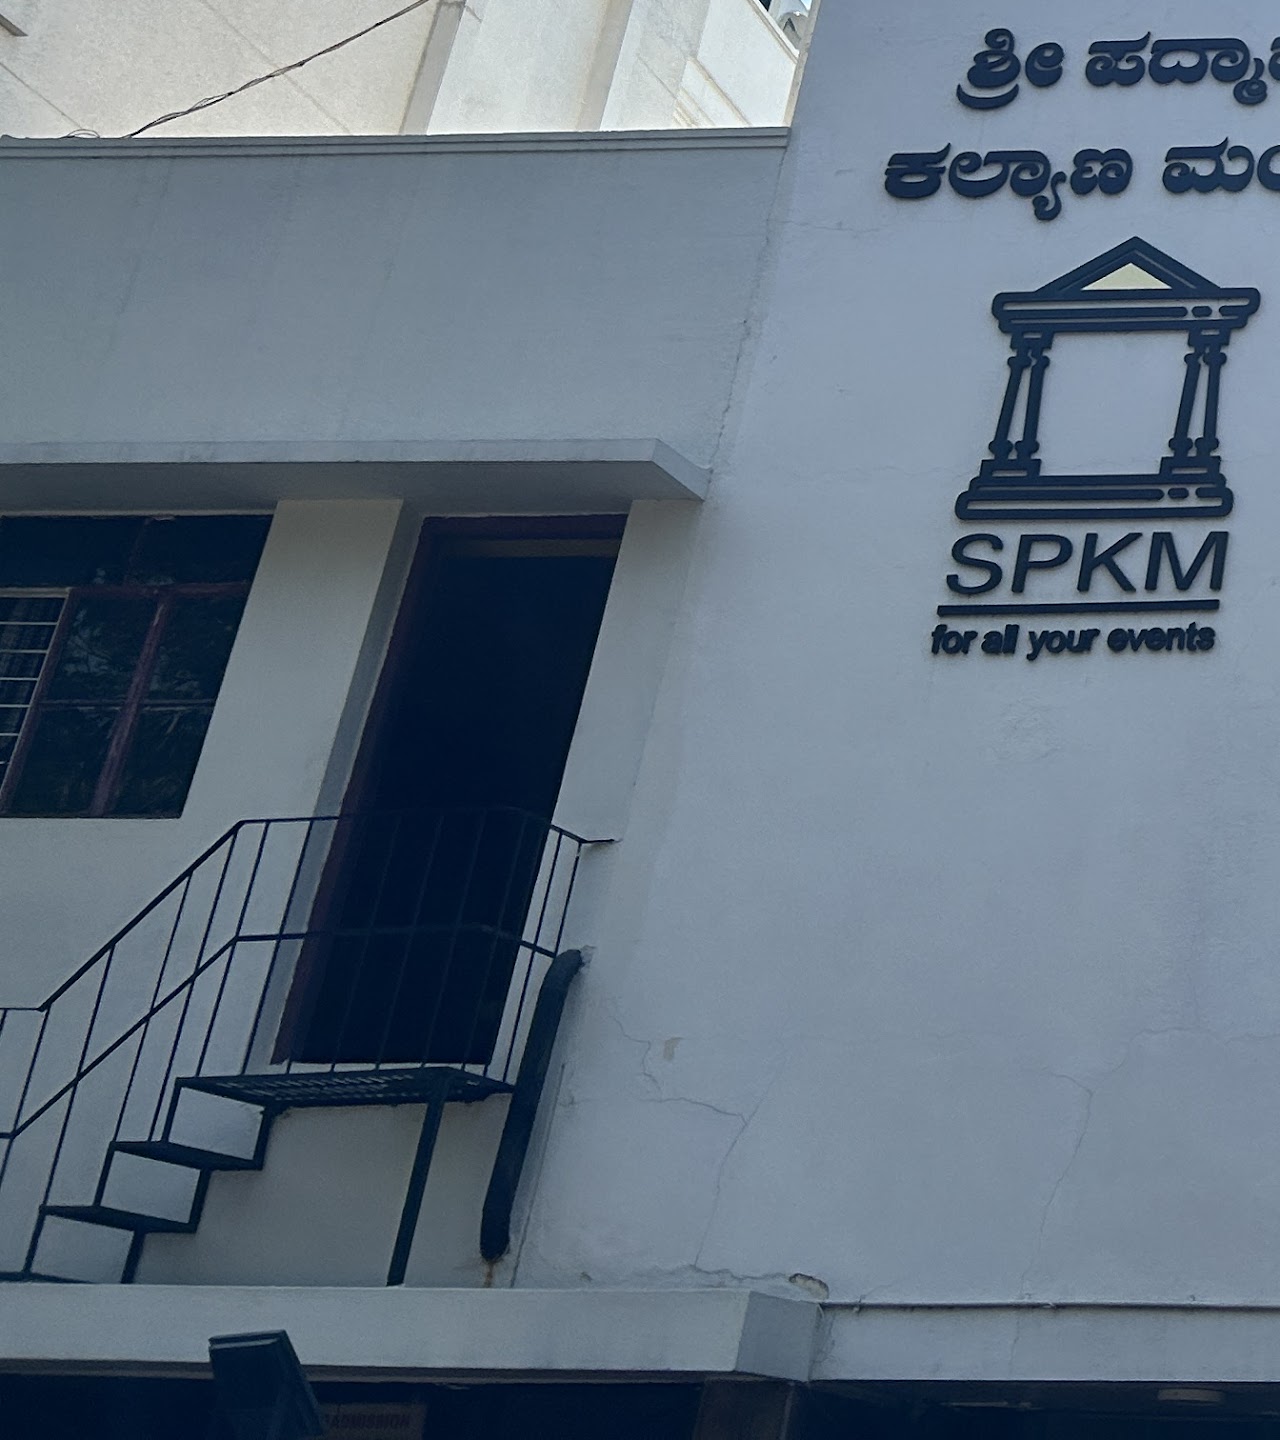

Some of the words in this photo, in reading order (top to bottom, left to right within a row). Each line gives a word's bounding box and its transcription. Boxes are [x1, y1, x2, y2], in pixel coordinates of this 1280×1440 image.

[955, 27, 1067, 113] ಶ್ರೀ
[883, 142, 1135, 223] ಕಲ್ಯಾಣ
[945, 530, 1230, 596] SPKM
[931, 624, 978, 656] for
[981, 623, 1018, 655] all
[1025, 628, 1101, 662] your
[1107, 621, 1216, 654] events
